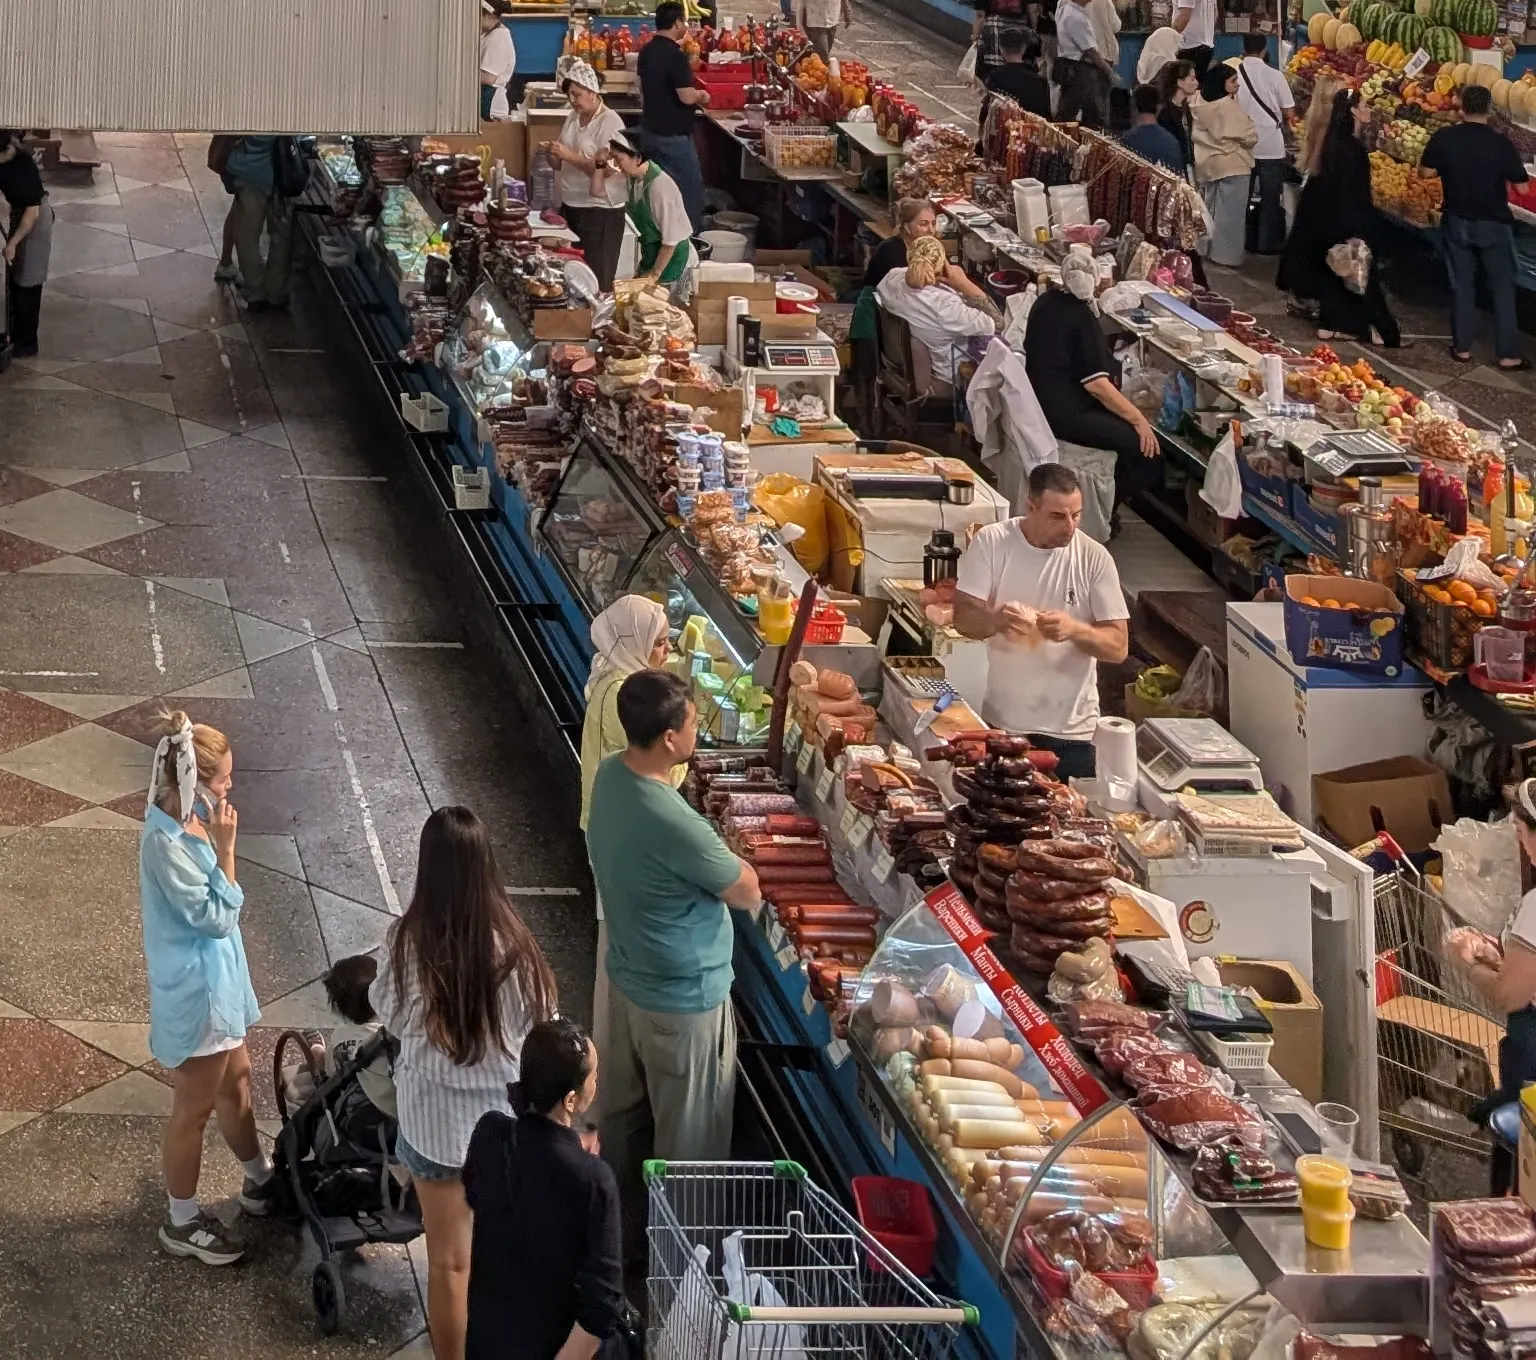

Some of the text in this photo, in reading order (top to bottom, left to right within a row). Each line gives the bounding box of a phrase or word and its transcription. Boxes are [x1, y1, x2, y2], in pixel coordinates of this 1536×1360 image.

[933, 898, 969, 942] Вареники
[945, 891, 983, 937] Пельмени
[969, 945, 998, 981] Манты
[1001, 988, 1034, 1032] Сырники
[1037, 1042, 1091, 1109] Хлеб домашний
[1050, 1034, 1088, 1080] Холодец
